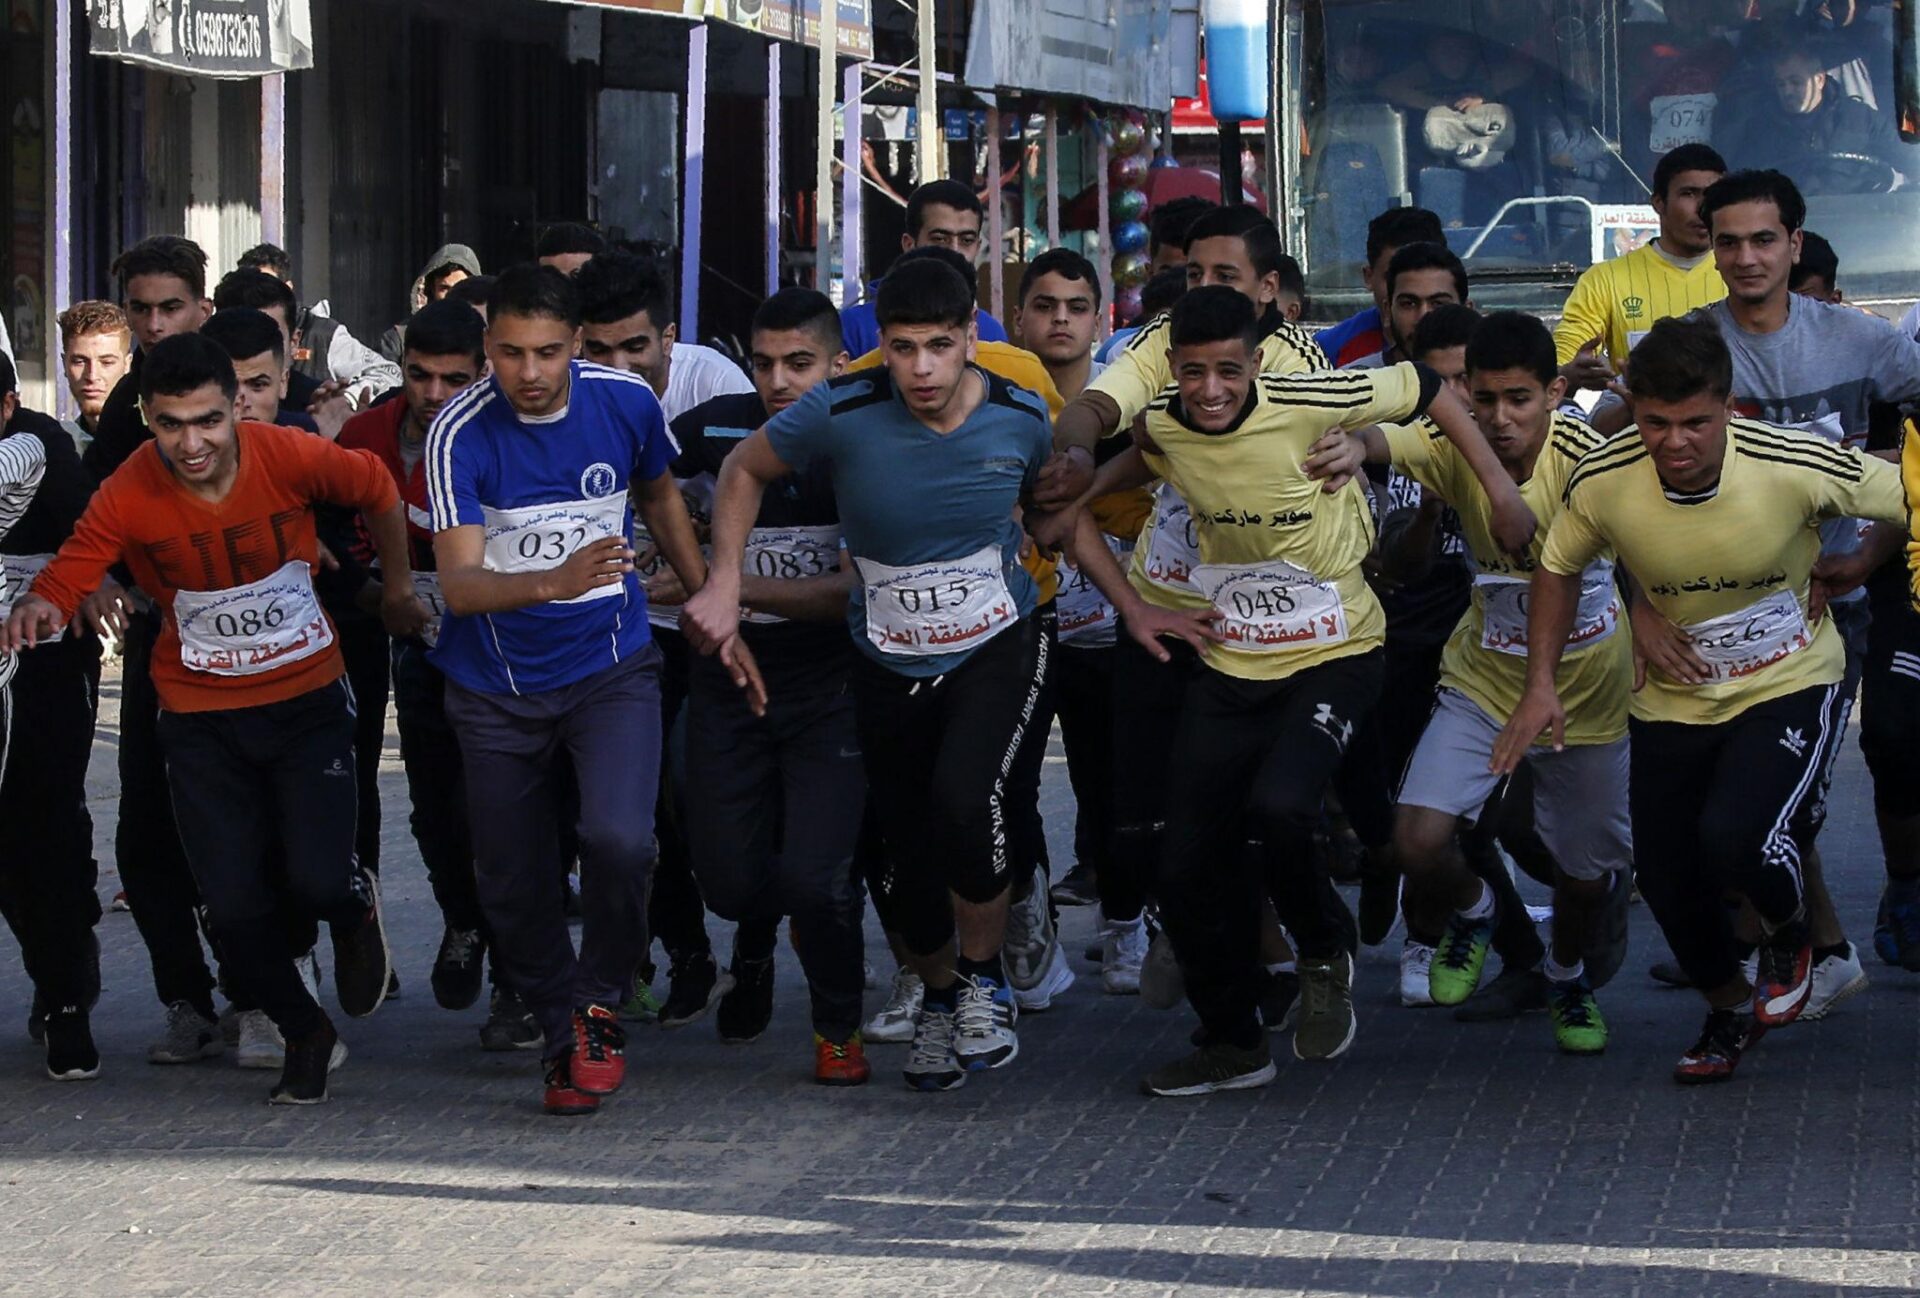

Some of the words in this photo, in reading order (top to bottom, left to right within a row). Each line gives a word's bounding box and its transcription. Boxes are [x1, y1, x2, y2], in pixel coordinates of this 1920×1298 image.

[1670, 110, 1705, 128] 074
[1268, 510, 1313, 528] سوبر
[518, 527, 586, 560] 032
[756, 550, 823, 580] 083
[1150, 556, 1191, 583] لقرن
[900, 578, 969, 614] 015
[1056, 571, 1092, 598] 24
[1681, 576, 1740, 592] ماركت
[993, 602, 1010, 624] لا
[1233, 586, 1296, 620] 048
[215, 597, 285, 637] 086
[923, 613, 991, 645] لصفقة
[1320, 613, 1338, 636] لا
[879, 624, 922, 646] العار
[1255, 618, 1317, 644] لصفقة
